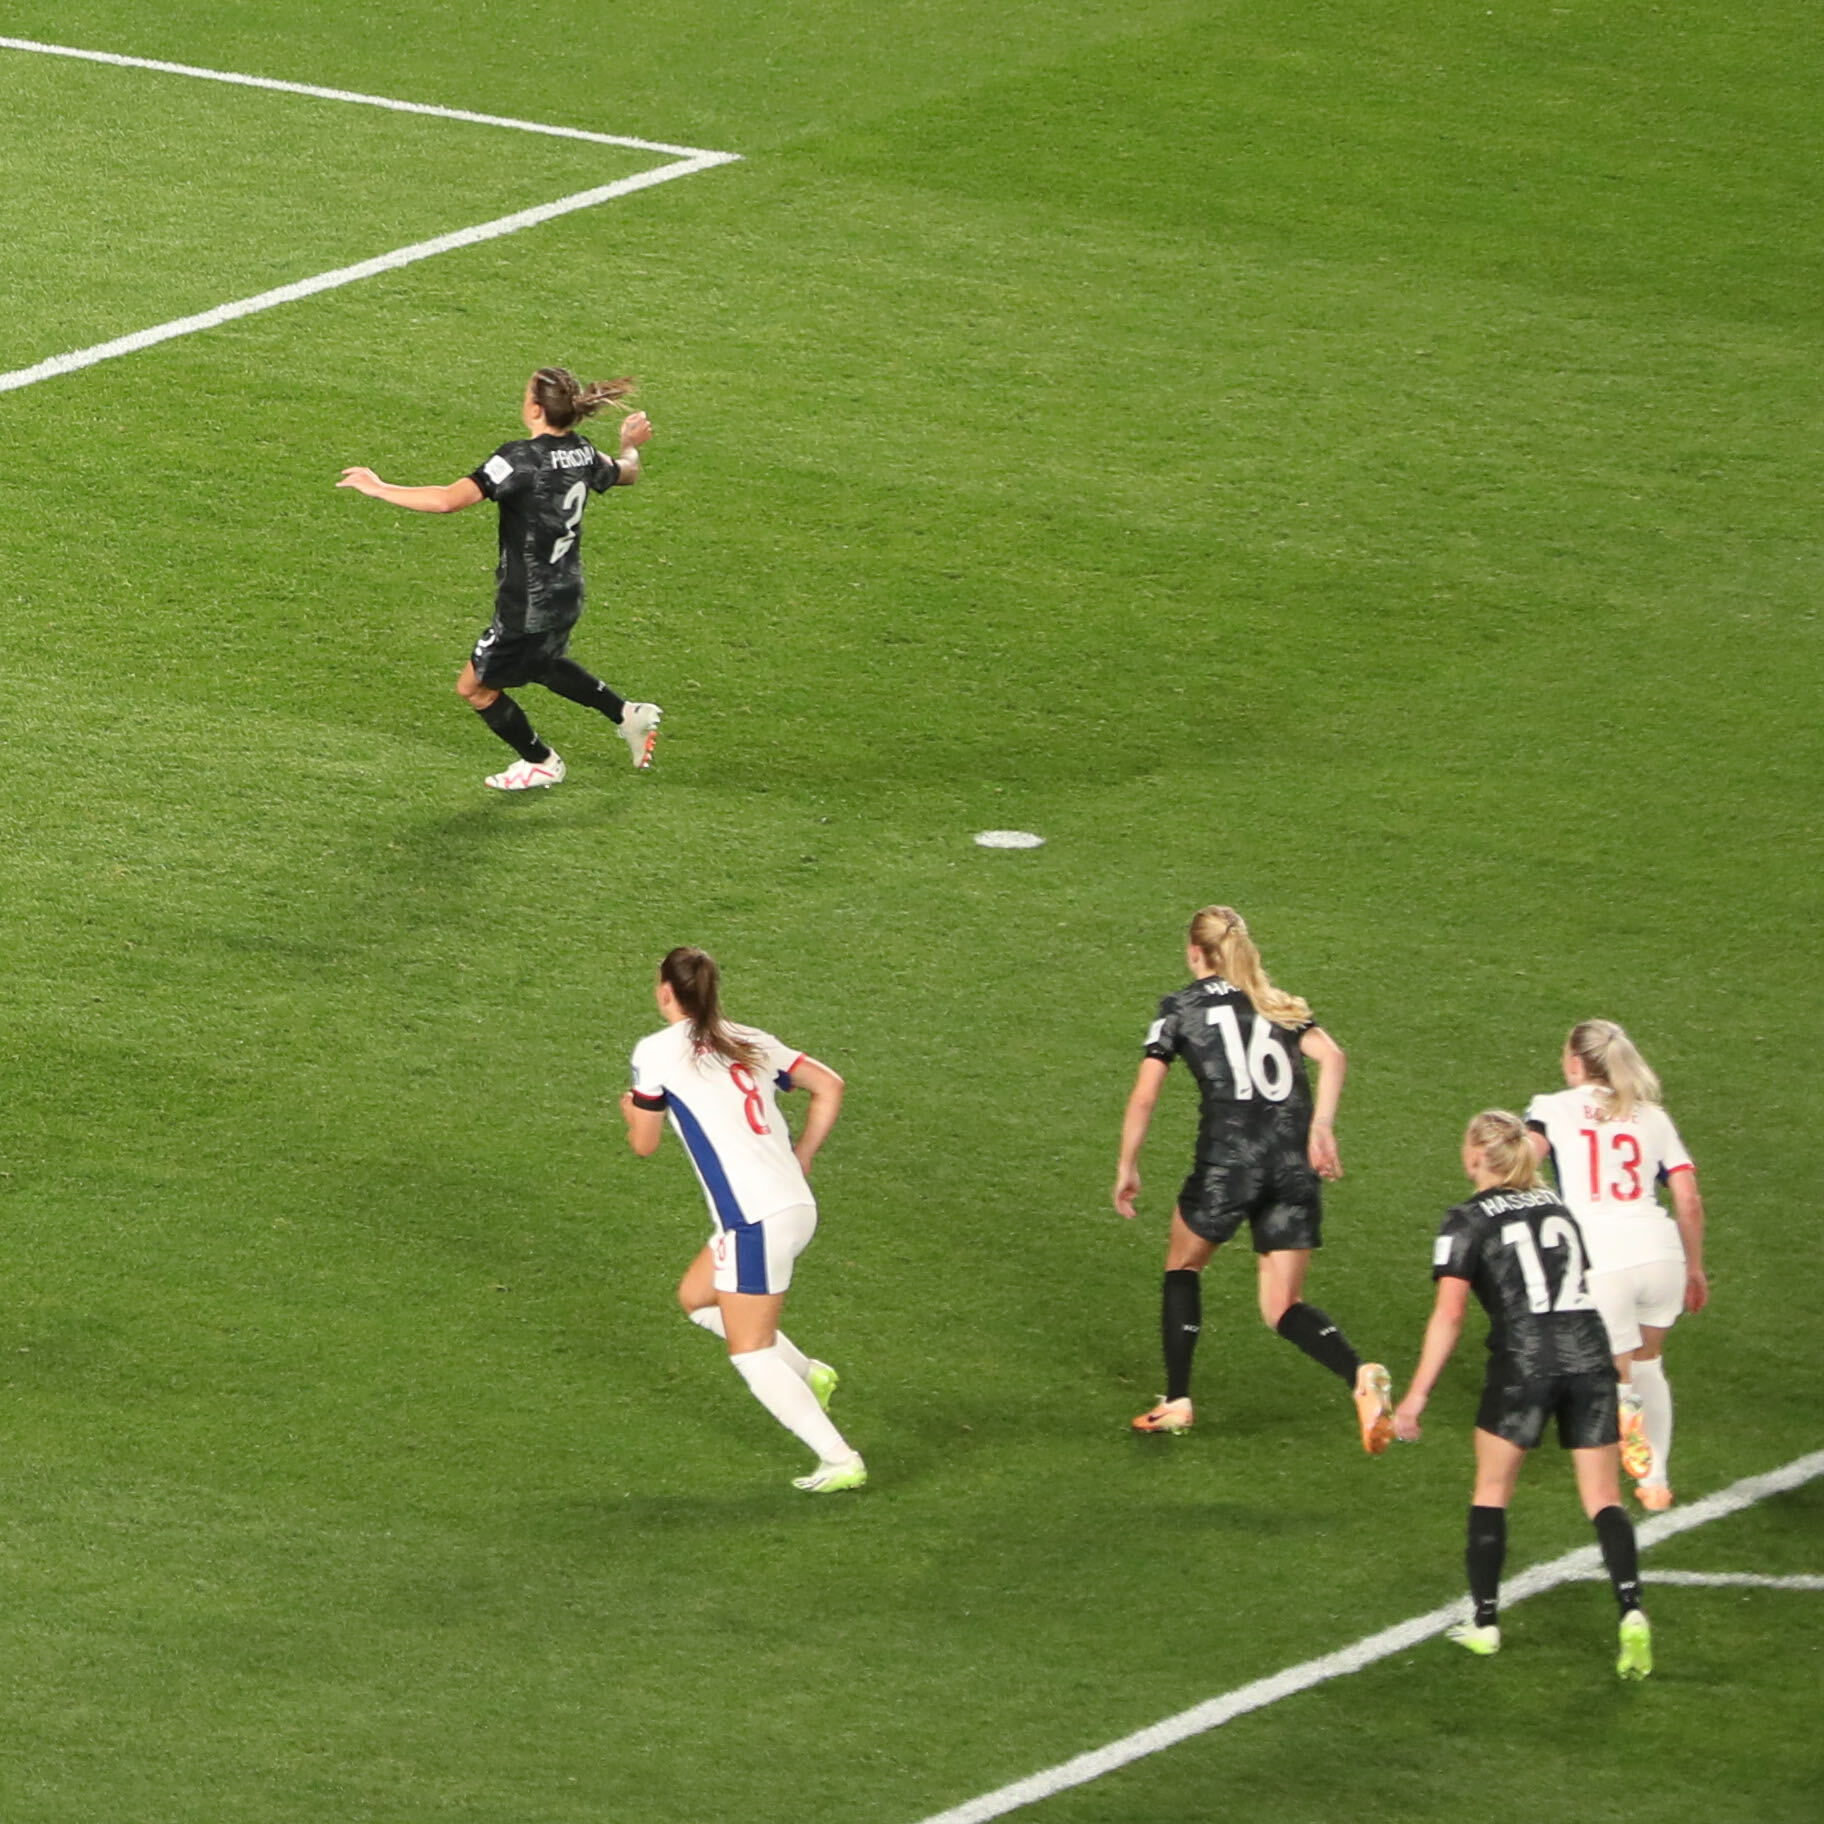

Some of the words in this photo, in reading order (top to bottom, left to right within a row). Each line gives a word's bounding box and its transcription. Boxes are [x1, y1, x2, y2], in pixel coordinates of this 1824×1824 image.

[548, 480, 587, 565] 2
[1205, 1004, 1294, 1103] 16
[729, 1062, 772, 1136] 8
[1578, 1128, 1643, 1203] 13
[1500, 1215, 1598, 1315] 12
